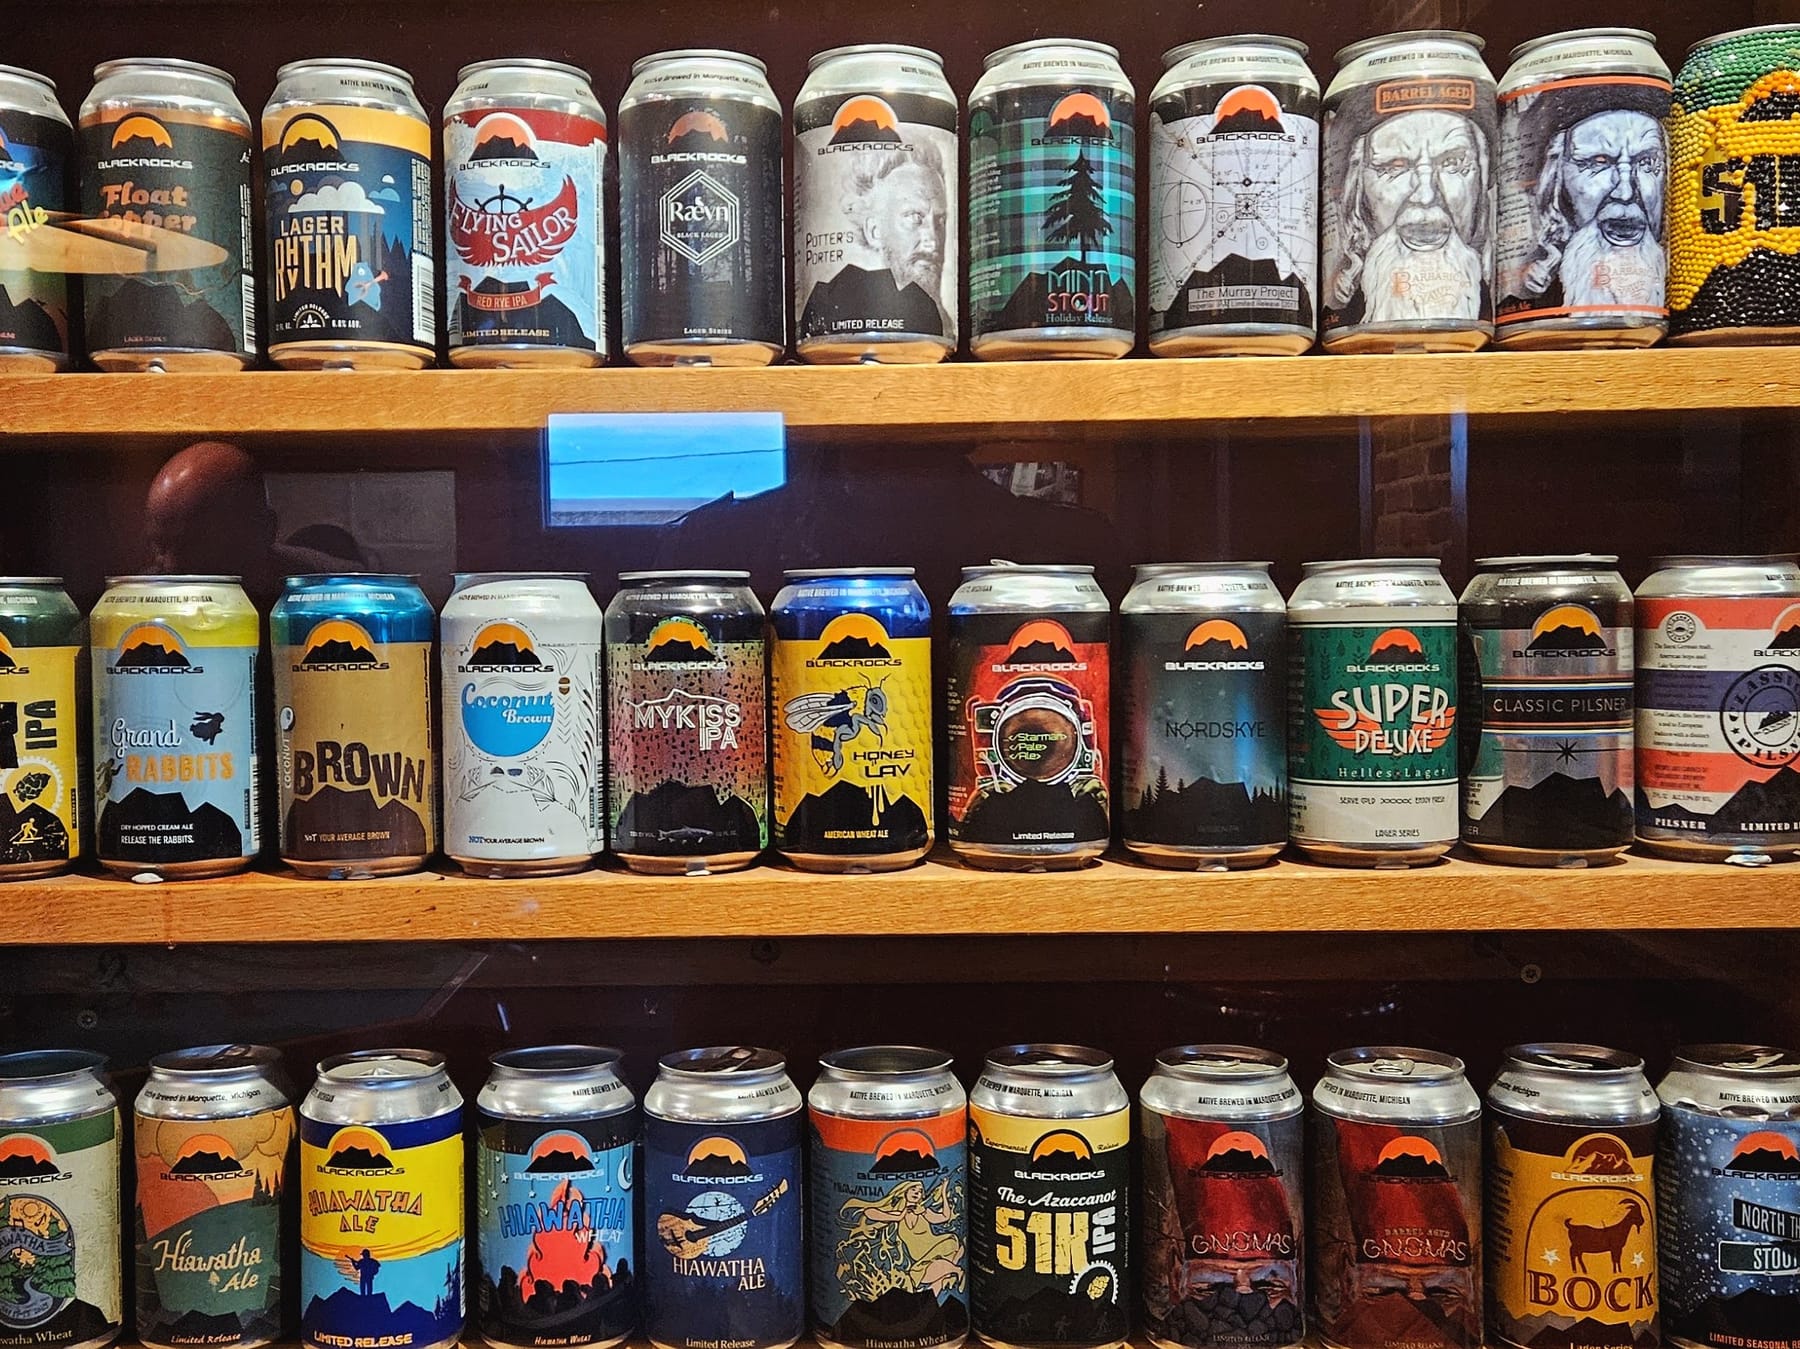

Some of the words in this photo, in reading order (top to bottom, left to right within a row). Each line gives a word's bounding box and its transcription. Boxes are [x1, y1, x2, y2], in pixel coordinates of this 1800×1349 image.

[1382, 87, 1434, 103] BARREL
[1439, 86, 1471, 99] AGED
[1197, 133, 1296, 145] BLACKROCKS
[818, 143, 914, 156] BLACKROCKS
[98, 158, 193, 170] BLACKROCKS
[459, 160, 551, 171] BLACKROCKS
[651, 152, 747, 164] BLACKROCKS
[271, 161, 360, 176] BLACKROCKS
[102, 181, 188, 208] Float
[8, 200, 49, 244] Ale
[454, 202, 522, 235] FLYING
[281, 216, 344, 237] LAGER
[492, 206, 578, 263] SAILOR
[805, 231, 854, 249] POTTER'S
[805, 249, 843, 267] PORTER
[1048, 269, 1109, 293] MINT
[1196, 289, 1215, 299] The
[1218, 287, 1257, 301] Murray
[1260, 286, 1294, 301] Project
[476, 295, 493, 309] RED
[494, 295, 511, 309] RYE
[512, 294, 528, 307] IPA
[1047, 292, 1110, 312] STOUT
[832, 319, 863, 331] LIMITED
[865, 318, 905, 330] RELEASE
[1046, 313, 1083, 323] Holiday
[1084, 313, 1113, 324] Release
[462, 328, 499, 338] LIMITED
[500, 327, 551, 338] RELEASE
[145, 596, 183, 604] MARQUETTE,
[1512, 649, 1617, 658] BLACKROCKS
[107, 666, 204, 675] BLACKROCKS
[292, 662, 389, 672] BLACKROCKS
[458, 664, 555, 674] BLACKROCKS
[632, 660, 729, 670] BLACKROCKS
[805, 659, 903, 668] BLACKROCKS
[992, 663, 1088, 673] BLACKROCKS
[1165, 662, 1265, 671] BLACKROCKS
[1346, 663, 1440, 673] BLACKROCKS
[462, 682, 555, 709] Coconut
[1331, 684, 1449, 730] SUPER
[1493, 698, 1564, 713] CLASSIC
[1571, 696, 1626, 712] PILSNER
[502, 709, 553, 724] Brown
[634, 703, 741, 729] MYKISS
[24, 700, 58, 750] IPA
[111, 718, 182, 759] Grand
[699, 726, 739, 750] IPA
[1355, 728, 1434, 756] DELUXE
[853, 749, 914, 766] HONEY
[126, 752, 235, 783] RABBITS
[294, 741, 425, 803] BROWN
[1339, 767, 1392, 778] Helles
[1404, 768, 1446, 779] Lager
[133, 824, 156, 832] HOPPED
[157, 823, 180, 831] CREAM
[182, 823, 193, 831] ALE
[1655, 817, 1707, 830] PILSNER
[1740, 822, 1790, 831] LIMITED
[121, 835, 147, 844] RELEASE
[149, 835, 161, 844] THE
[304, 833, 317, 842] NOT
[319, 833, 335, 842] YOUR
[336, 832, 365, 841] AVERAGE
[367, 831, 390, 840] BROWN
[468, 836, 484, 844] NOT
[824, 830, 855, 839] AMERICAN
[856, 830, 876, 839] WHEAT
[877, 830, 889, 838] ALE
[1013, 832, 1043, 840] Limited
[1044, 831, 1075, 840] Release
[1375, 829, 1398, 838] LAGER
[1399, 828, 1420, 837] SERIES
[850, 1090, 868, 1100] NATIVE
[1008, 1085, 1042, 1098] MARQUETTE,
[1344, 1089, 1378, 1104] MARQUETTE,
[1379, 1095, 1411, 1105] MICHIGAN
[1719, 1092, 1740, 1103] NATIVE
[1742, 1094, 1770, 1104] BREWED
[1771, 1096, 1779, 1104] IN
[1198, 1096, 1218, 1105] NATIVE
[1219, 1097, 1245, 1106] BREWED
[160, 1169, 254, 1181] BLACKROCKS
[316, 1164, 406, 1177] BLACKROCKS
[514, 1169, 605, 1181] BLACKROCKS
[856, 1168, 950, 1181] BLACKROCKS
[1014, 1170, 1106, 1182] BLACKROCKS
[1551, 1172, 1644, 1183] BLACKROCKS
[672, 1173, 764, 1185] BLACKROCKS
[308, 1188, 423, 1217] HIAWATHA
[997, 1186, 1027, 1205] The
[1027, 1189, 1118, 1207] Azaccanot
[339, 1214, 380, 1234] ALE
[499, 1197, 627, 1239] HIAWATHA
[1741, 1202, 1785, 1237] NORTH
[575, 1229, 624, 1244] WHEAT
[1384, 1228, 1424, 1237] BARREL
[995, 1206, 1090, 1275] 51K
[1092, 1206, 1116, 1256] IPA
[1191, 1231, 1293, 1254] GNOMAS
[154, 1229, 262, 1272] Hiawatha
[1362, 1236, 1468, 1261] GNOMAS
[673, 1256, 766, 1277] HIAWATHA
[218, 1273, 259, 1294] Ale
[737, 1274, 767, 1292] ALE
[1527, 1268, 1655, 1313] BOCK
[35, 1330, 73, 1343] Wheat
[171, 1335, 205, 1345] Limited
[207, 1332, 242, 1344] Release
[313, 1330, 353, 1347] LIMITED
[354, 1333, 413, 1348] RELEASE
[686, 1337, 719, 1349] Limited
[720, 1338, 756, 1349] Release
[865, 1338, 916, 1349] Hiawatha
[918, 1334, 949, 1348] Wheat
[1708, 1331, 1744, 1347] LIMITED
[1746, 1337, 1790, 1349] SEASONAL
